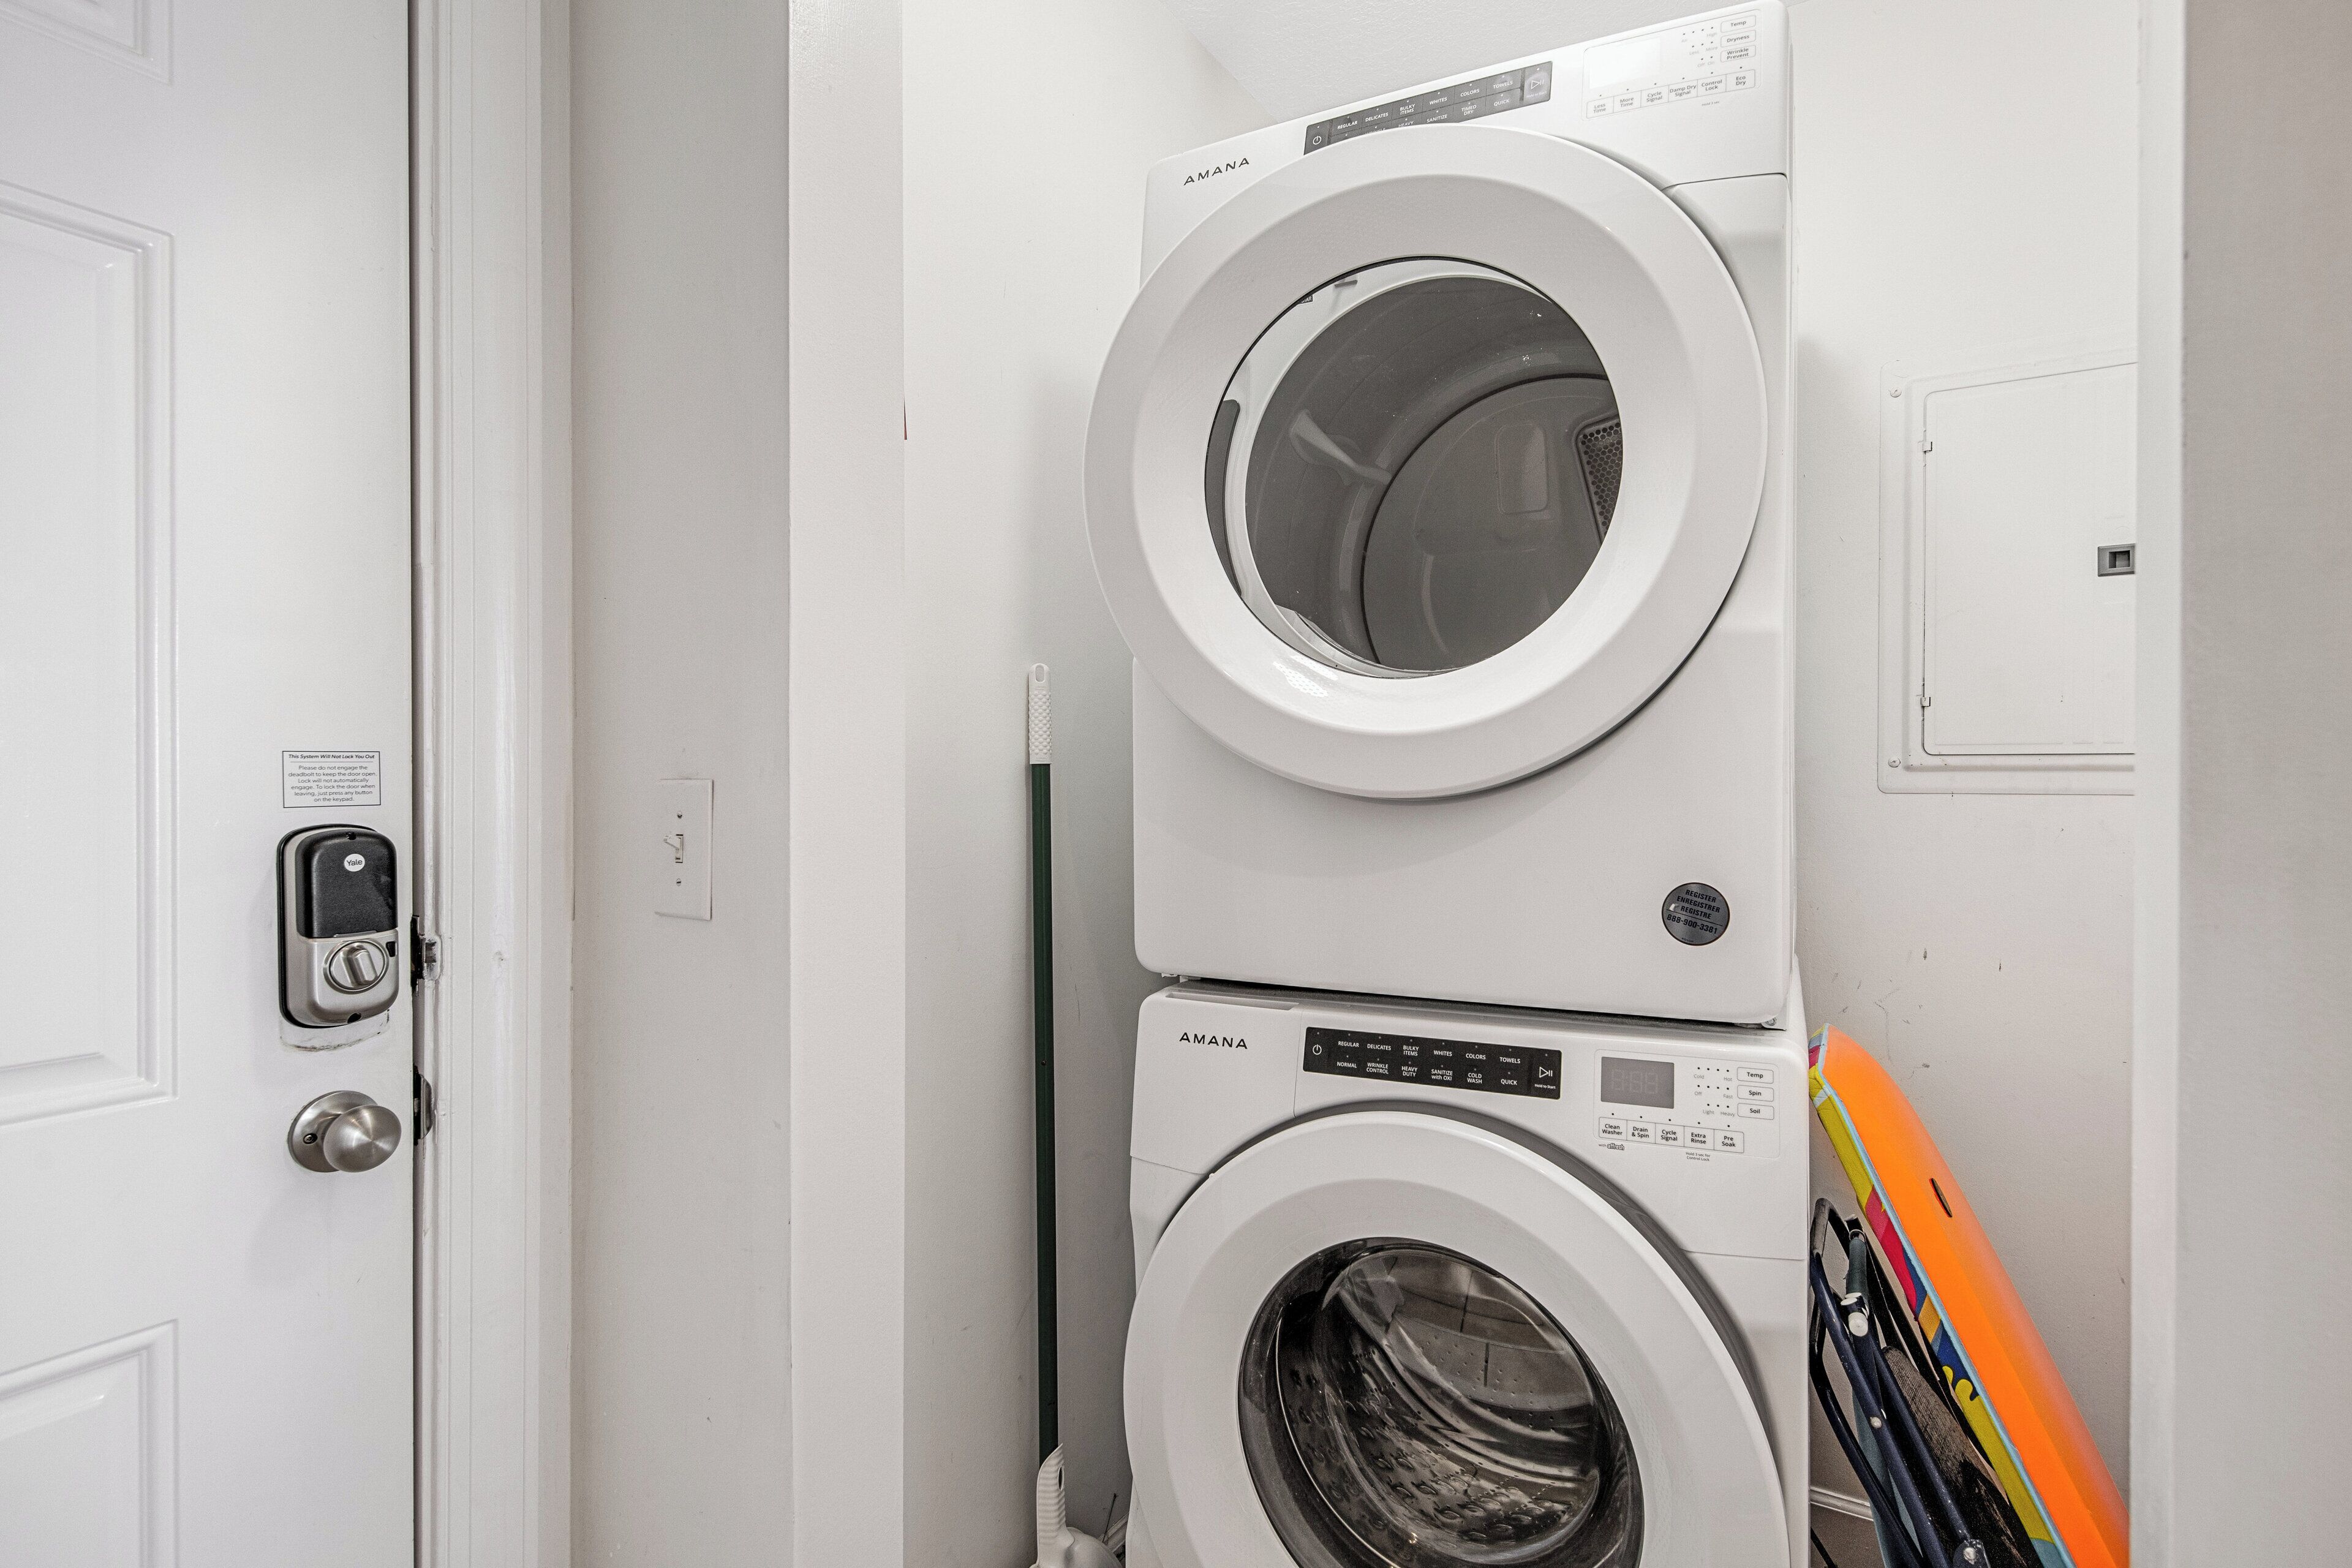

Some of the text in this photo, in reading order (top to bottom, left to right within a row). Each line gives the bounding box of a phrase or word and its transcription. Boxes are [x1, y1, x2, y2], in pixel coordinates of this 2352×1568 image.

[1365, 112, 1389, 122] DELICATES
[1427, 114, 1447, 123] SANITIZE
[1338, 121, 1357, 130] REGULAR
[1183, 157, 1250, 186] AMANA
[1686, 889, 1716, 902] REGISTER
[1677, 896, 1721, 913] ENREGISTRER
[1681, 906, 1712, 919] REGISTRE
[1667, 914, 1717, 933] 888-900-3381
[1179, 1032, 1248, 1049] AMANA
